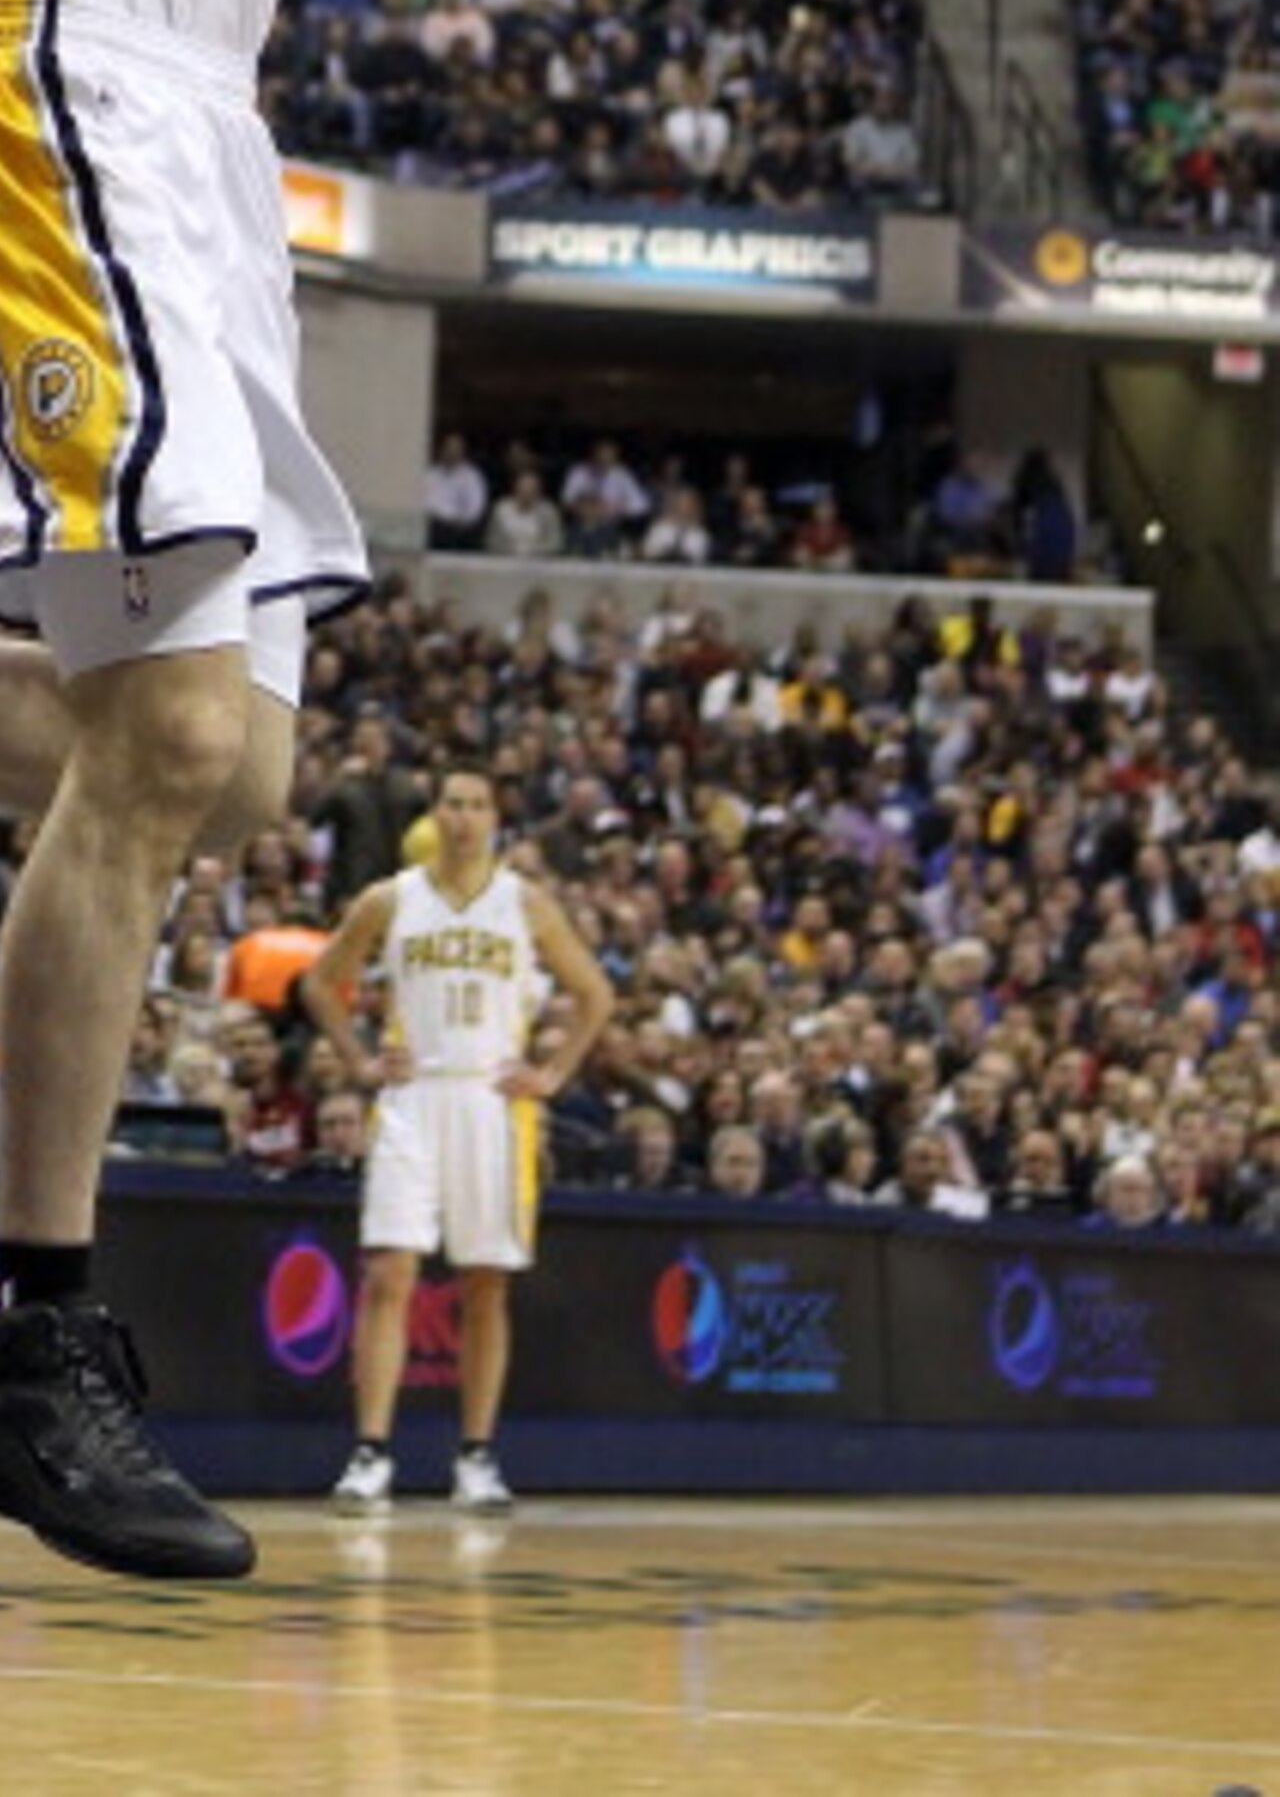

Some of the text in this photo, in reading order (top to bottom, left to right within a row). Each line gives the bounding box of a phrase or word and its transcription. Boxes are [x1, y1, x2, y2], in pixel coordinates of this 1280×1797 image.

[492, 218, 872, 279] SPORT GRAPHICS
[1092, 239, 1275, 297] Community
[402, 927, 514, 980] PACERS
[444, 981, 485, 1029] 10
